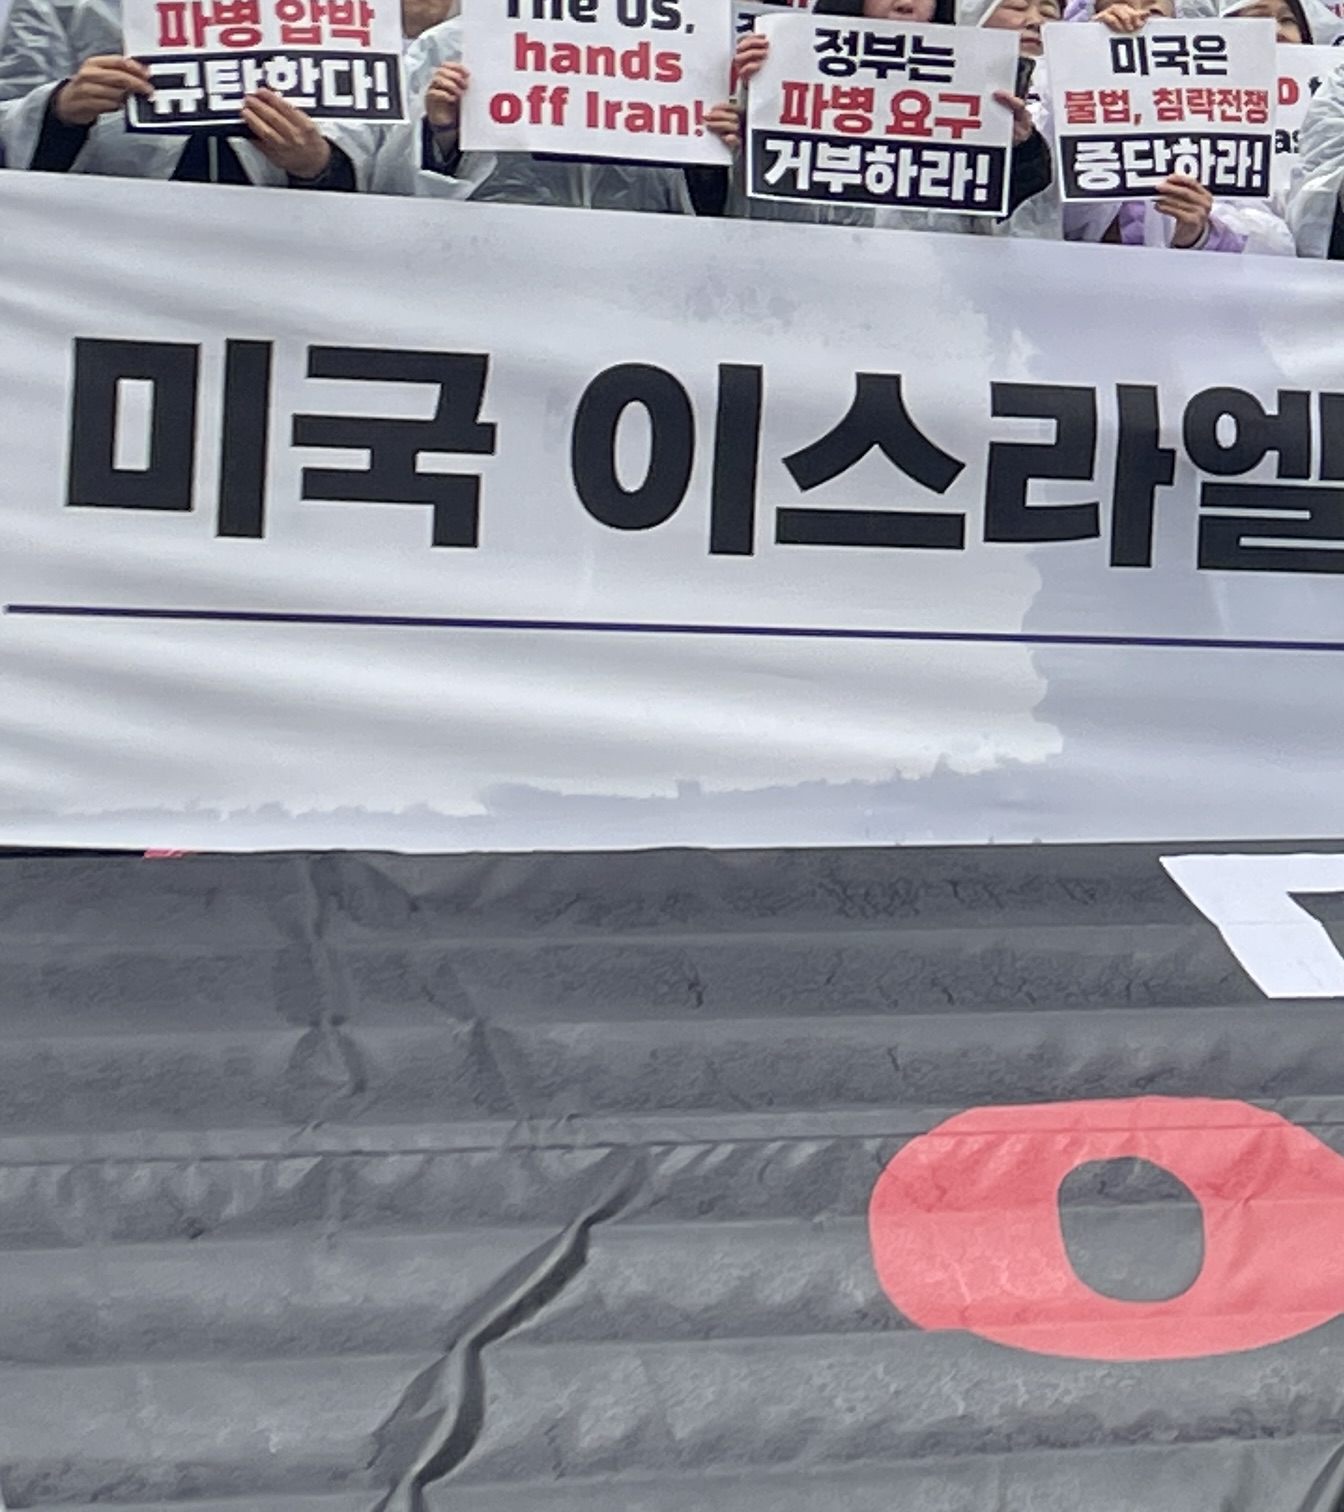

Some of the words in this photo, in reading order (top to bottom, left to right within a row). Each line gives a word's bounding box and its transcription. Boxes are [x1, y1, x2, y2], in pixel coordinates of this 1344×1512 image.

[155, 0, 261, 48] 파병
[514, 32, 683, 83] hands
[814, 27, 956, 83] 정부는
[1109, 35, 1228, 76] 미국은
[149, 56, 390, 112] 규탄한다!
[1064, 89, 1142, 126] 불법,
[1152, 87, 1269, 125] 침략전쟁
[489, 86, 569, 126] off
[585, 91, 705, 137] Iran!
[780, 81, 875, 134] 파병
[885, 89, 982, 139] 요구
[764, 139, 988, 202] 거부하라!
[1075, 138, 1262, 189] 중단하라!
[65, 337, 498, 548] 미국
